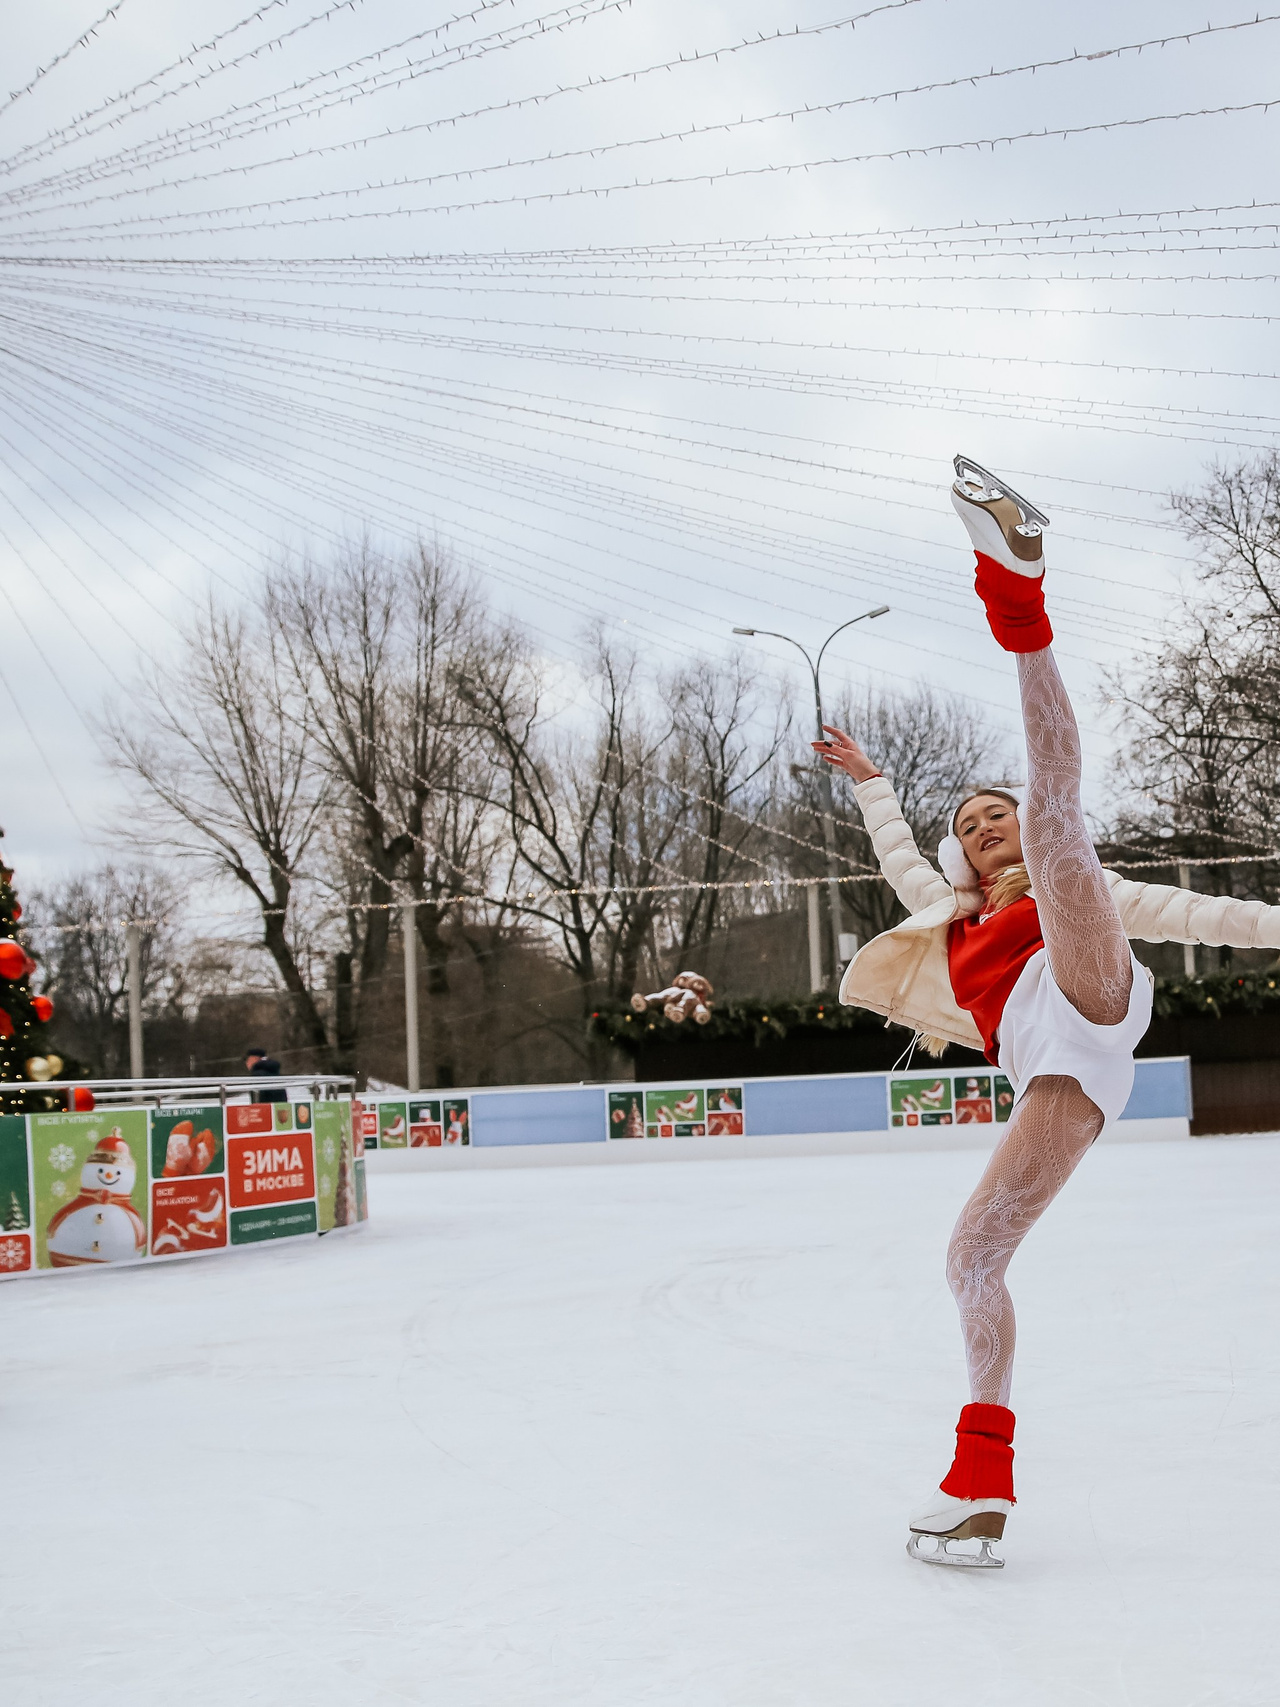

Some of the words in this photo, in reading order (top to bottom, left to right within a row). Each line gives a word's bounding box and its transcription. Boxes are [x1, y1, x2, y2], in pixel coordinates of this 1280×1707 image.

[242, 1146, 304, 1176] ЗИМА
[243, 1178, 253, 1193] В
[255, 1173, 304, 1191] МОСКВЕ
